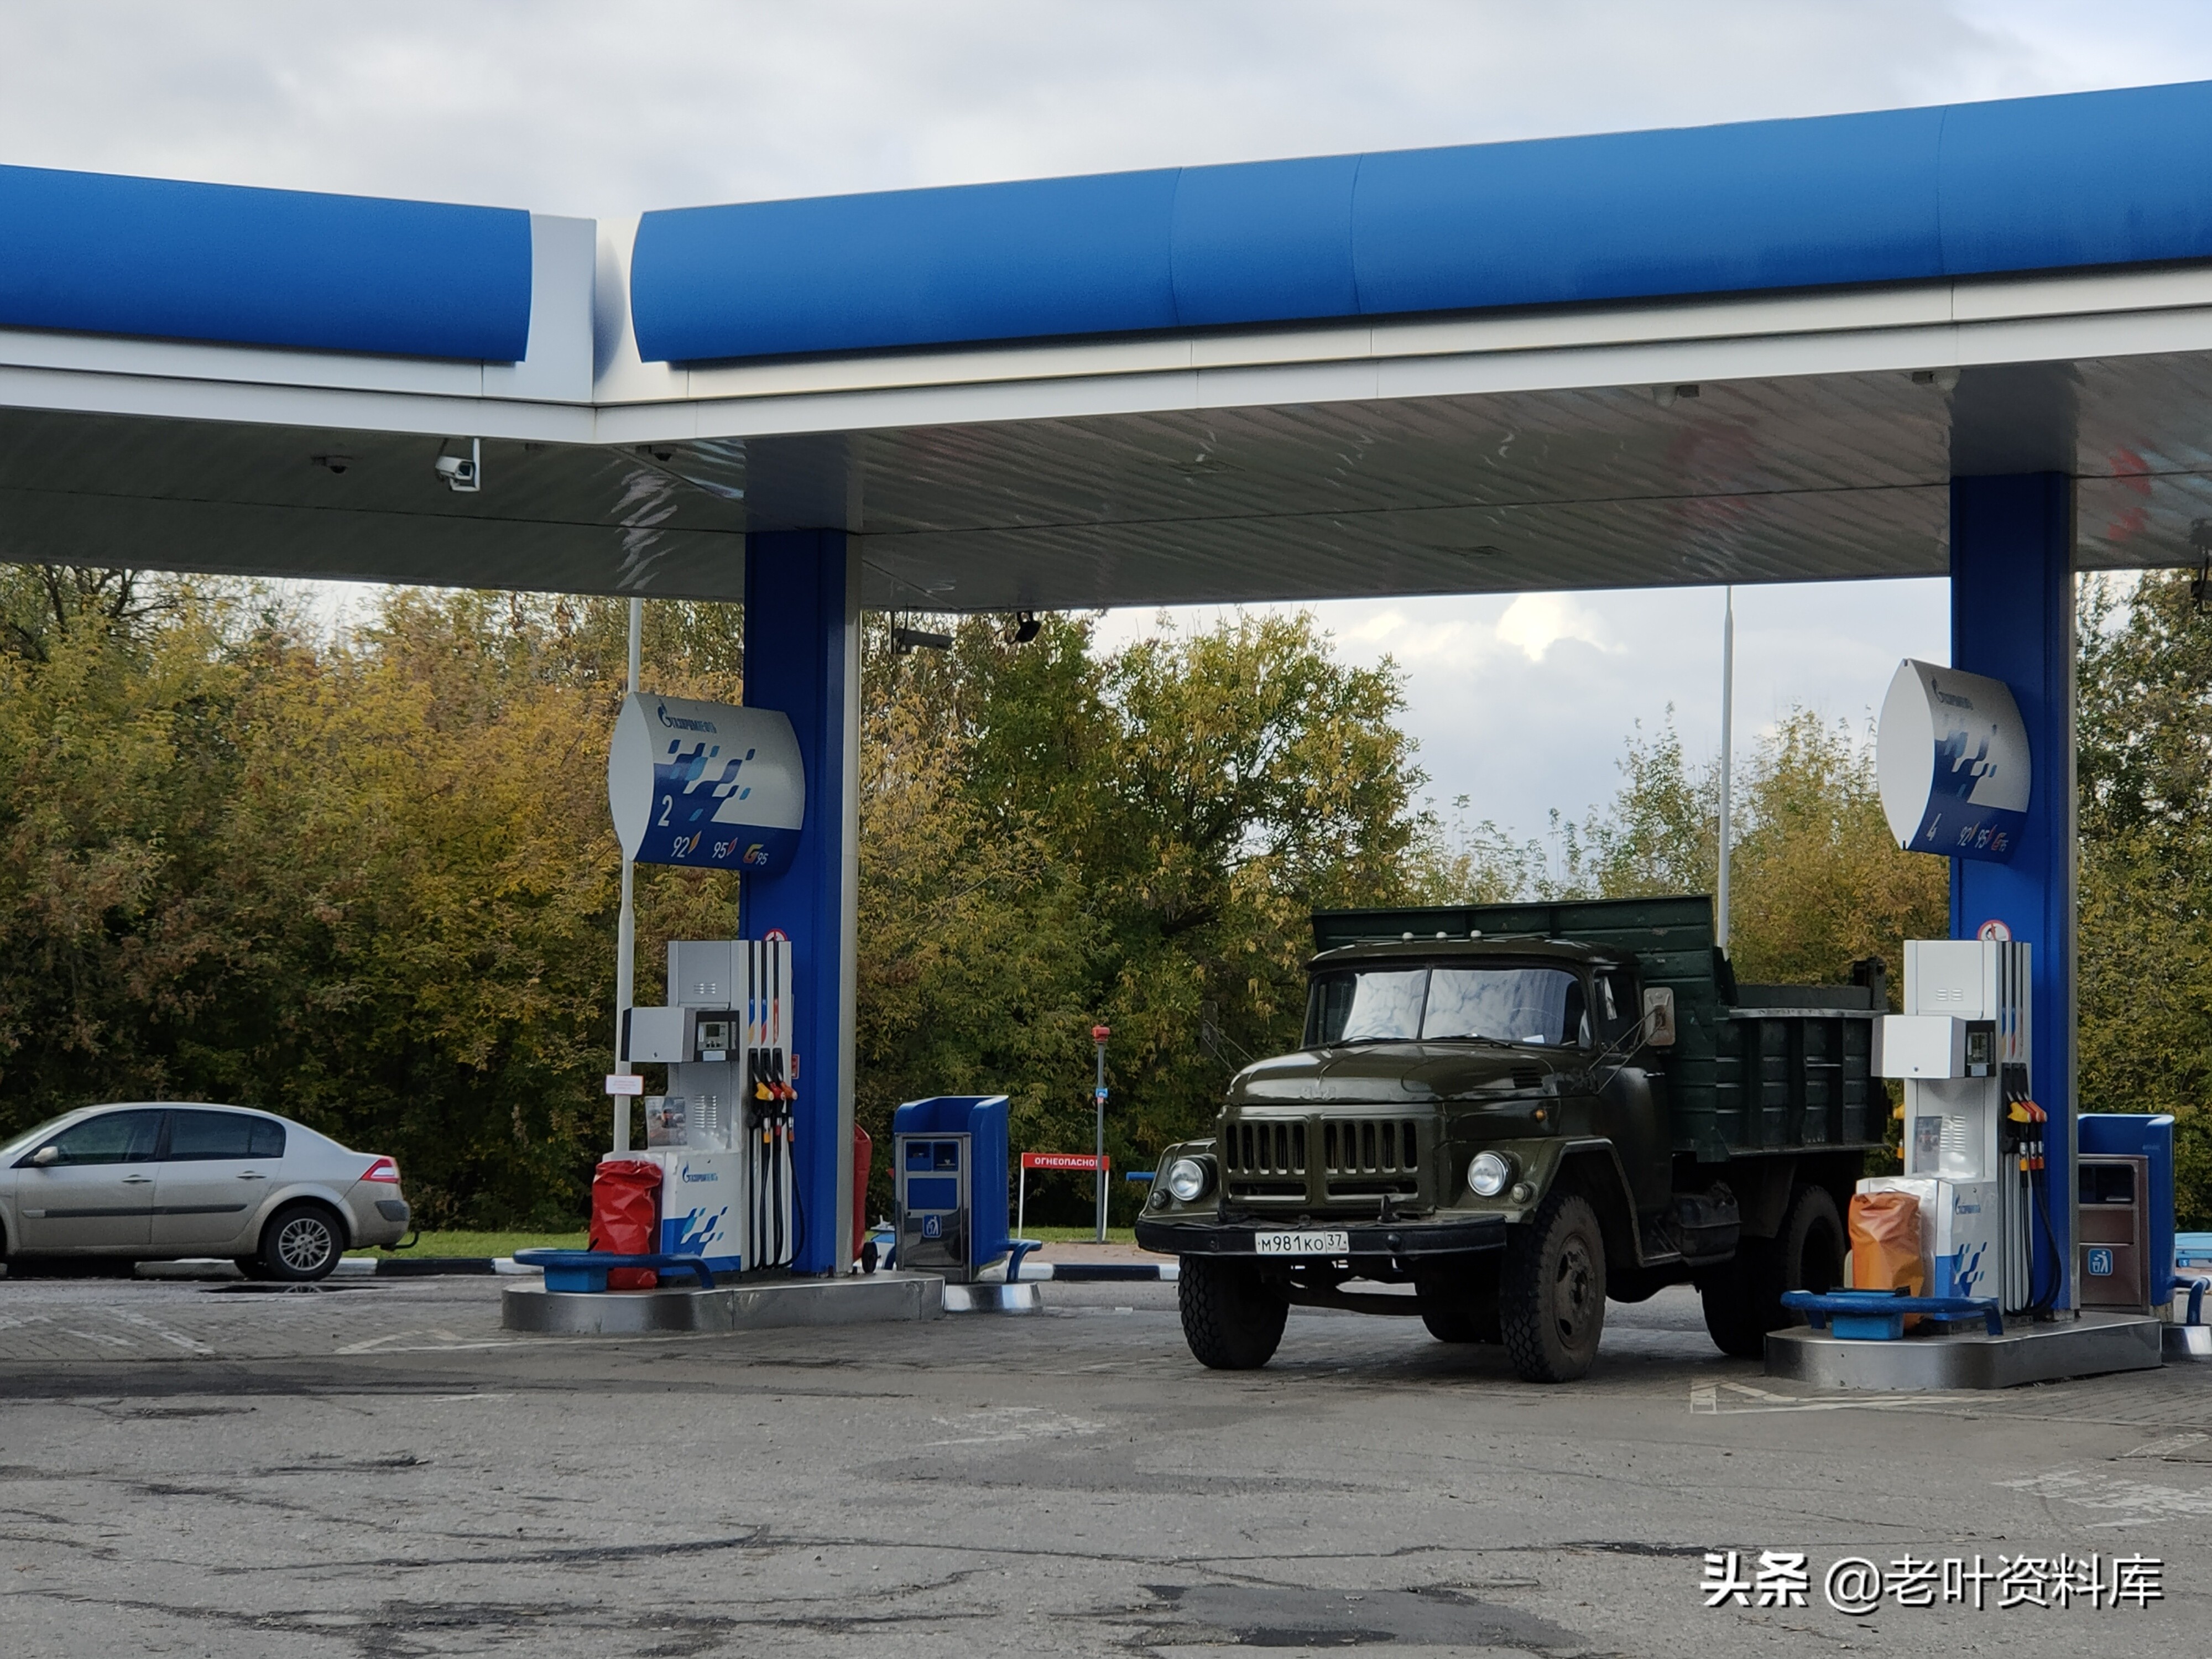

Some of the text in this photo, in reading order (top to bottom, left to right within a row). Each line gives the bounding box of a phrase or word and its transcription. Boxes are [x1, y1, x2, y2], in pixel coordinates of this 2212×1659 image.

[658, 795, 673, 827] 2
[671, 836, 690, 858] 92
[712, 842, 729, 859] 95
